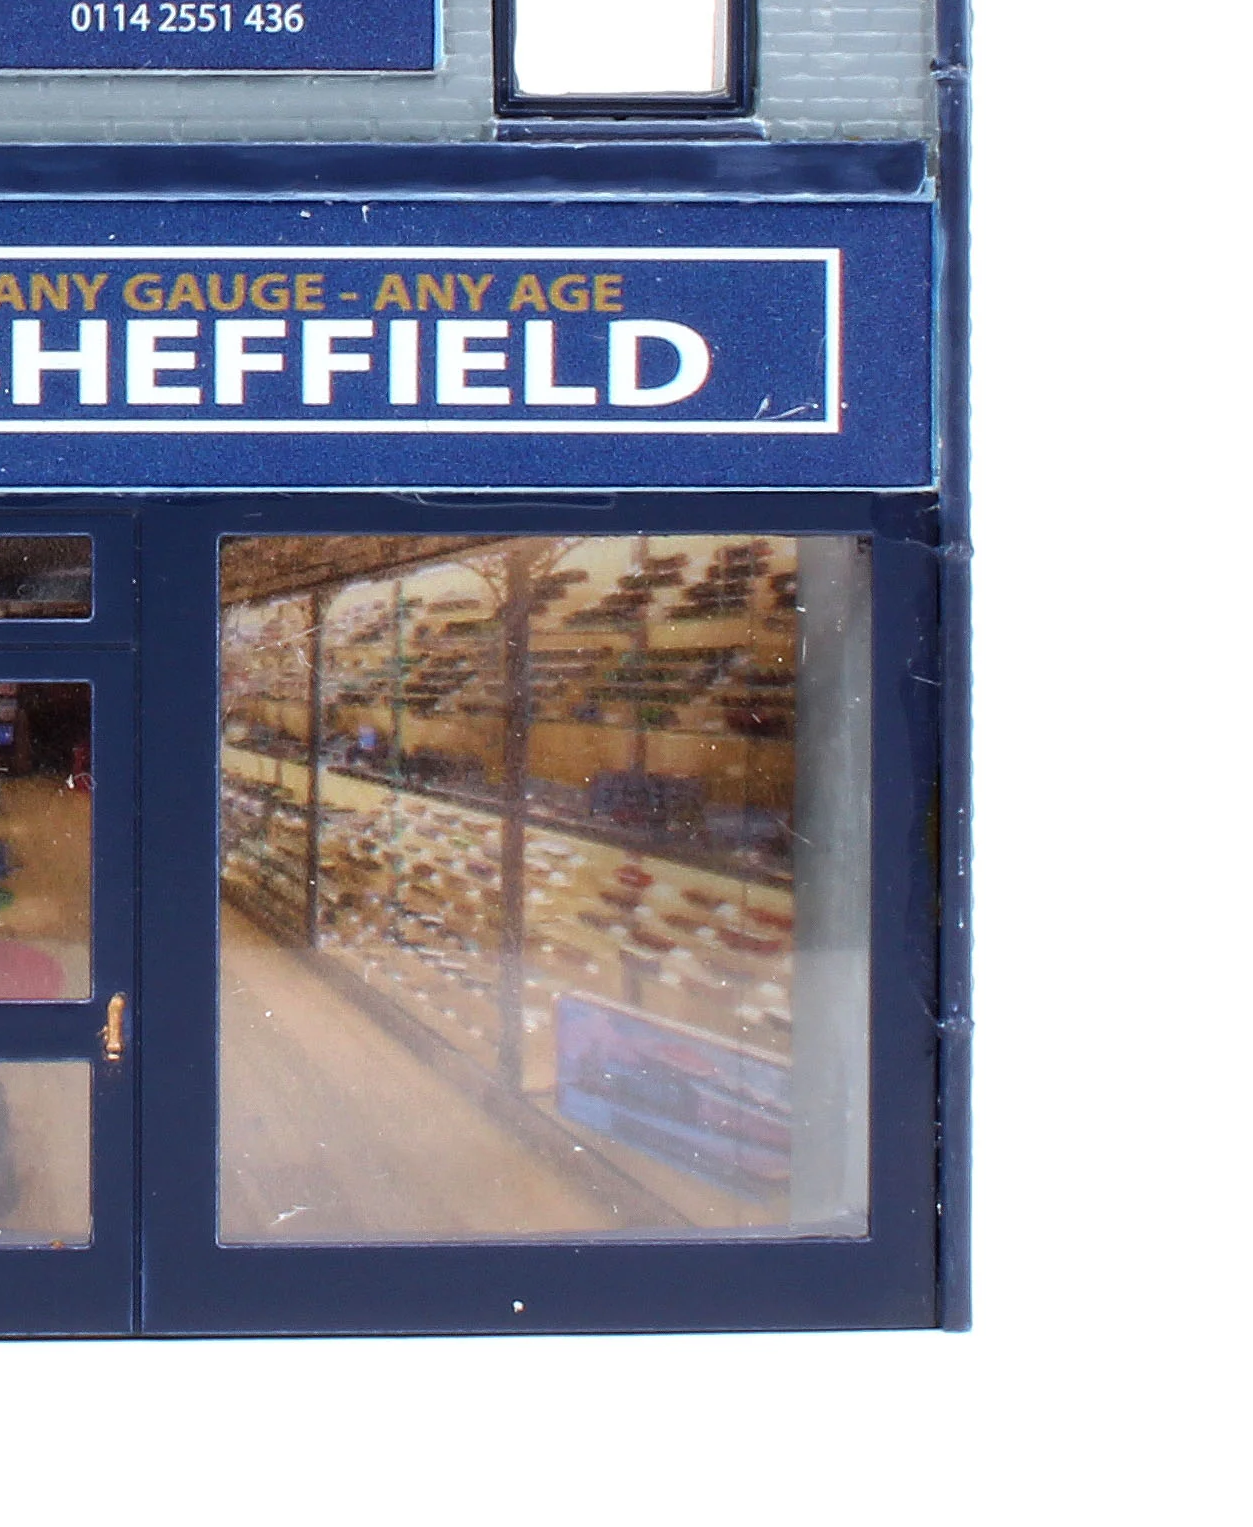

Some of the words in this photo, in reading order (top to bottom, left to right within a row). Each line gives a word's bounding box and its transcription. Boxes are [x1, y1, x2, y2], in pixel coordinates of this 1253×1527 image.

[70, 1, 151, 33] 0114
[158, 2, 233, 33] 2551
[244, 2, 305, 33] 436
[123, 272, 326, 312] GAUGE
[374, 273, 495, 312] ANY
[509, 273, 625, 313] AGE
